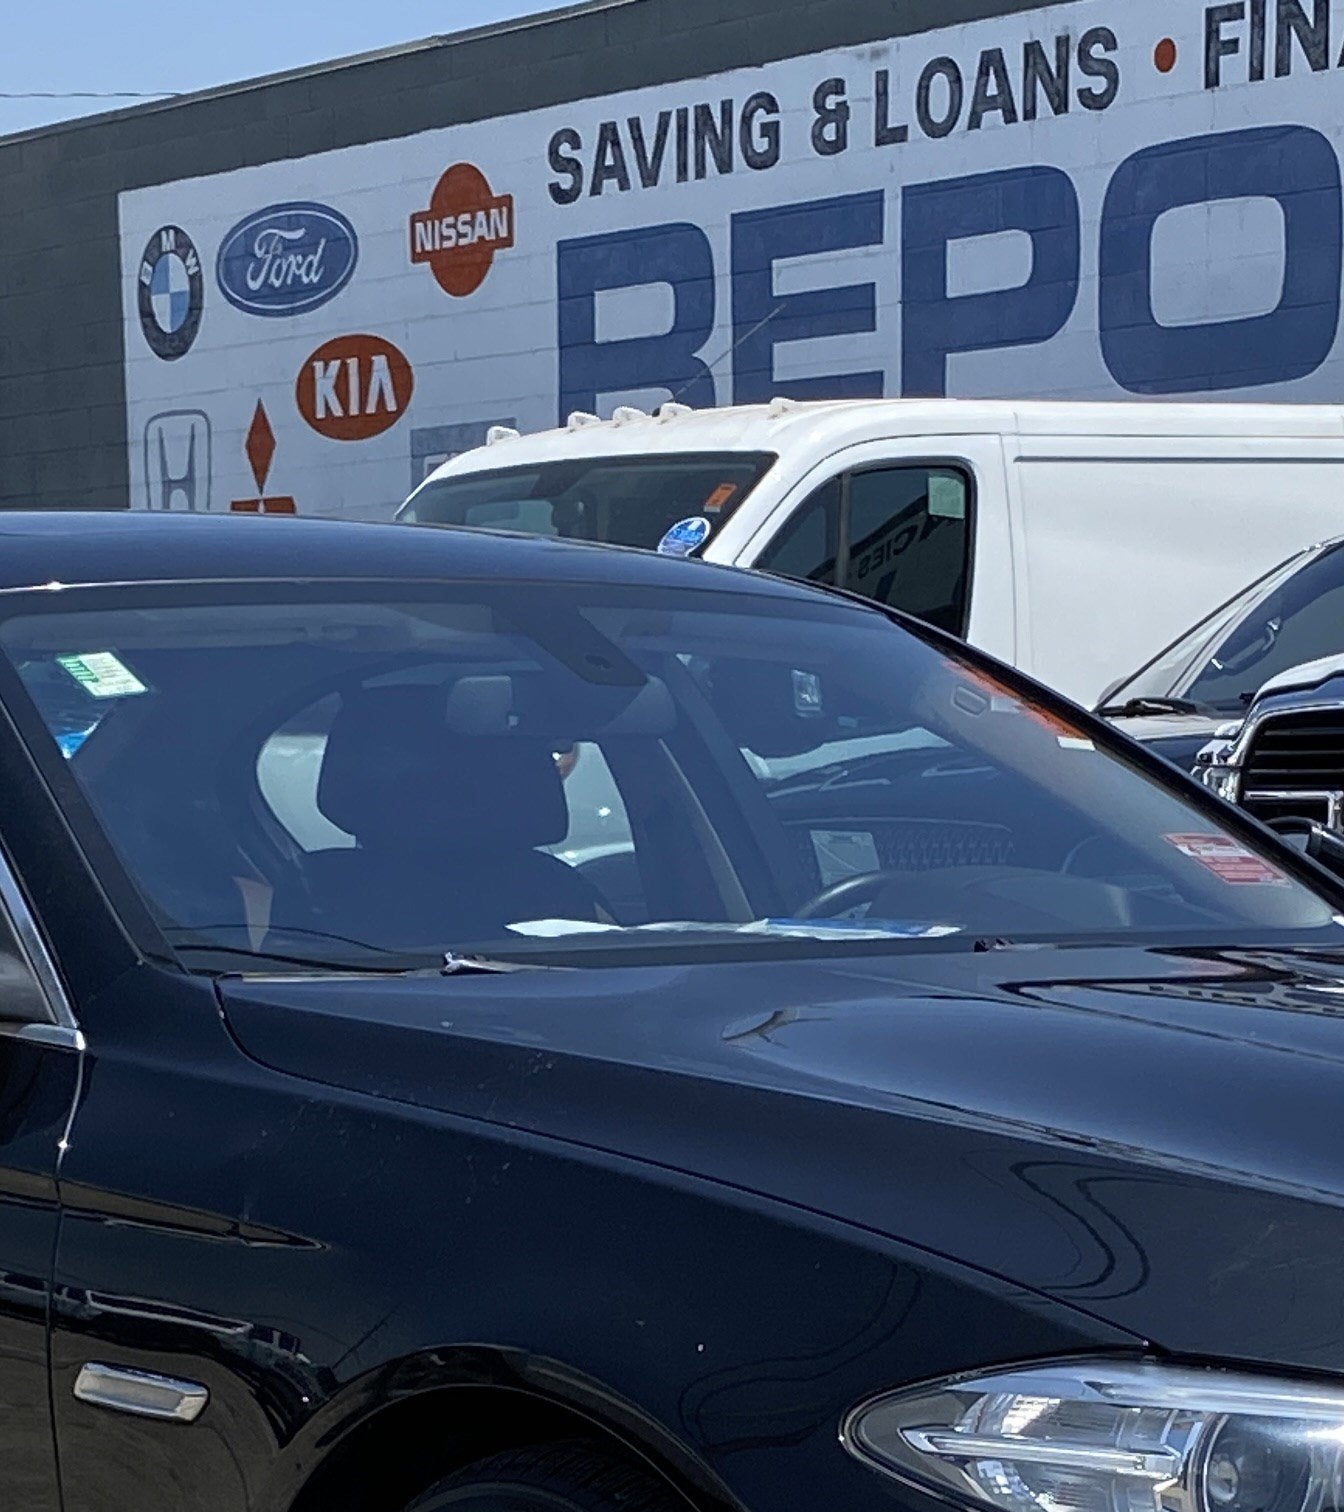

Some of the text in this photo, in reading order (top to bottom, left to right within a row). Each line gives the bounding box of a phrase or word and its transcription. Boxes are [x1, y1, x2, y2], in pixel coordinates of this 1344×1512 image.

[547, 91, 781, 205] SAVING
[811, 77, 848, 157] &
[875, 27, 1119, 148] LOANS
[139, 228, 199, 285] BMW
[246, 227, 327, 291] Ford
[413, 204, 509, 254] NISSAN
[312, 354, 397, 420] KIA
